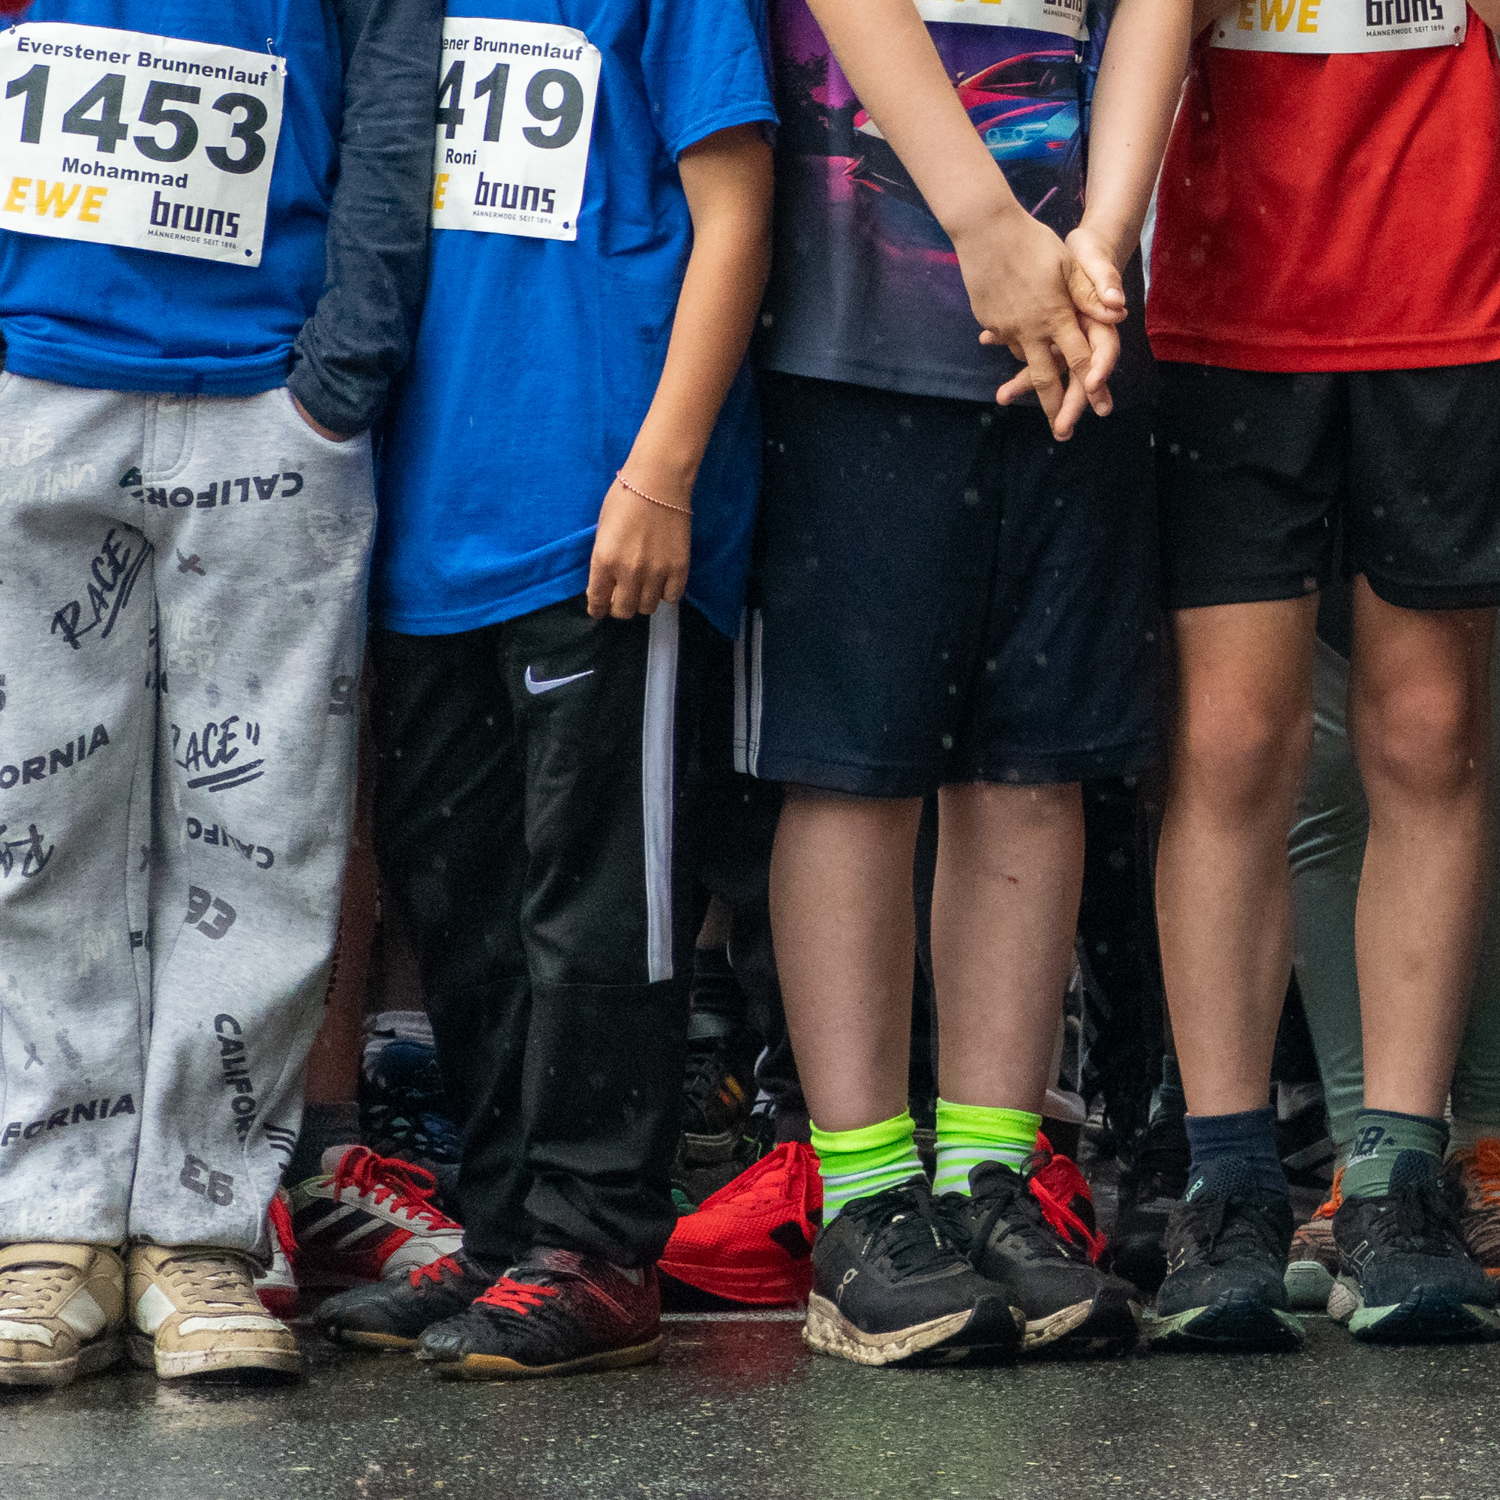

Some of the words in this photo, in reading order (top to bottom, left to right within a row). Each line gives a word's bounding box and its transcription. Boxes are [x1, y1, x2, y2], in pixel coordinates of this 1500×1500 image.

[17, 37, 131, 65] Everstener
[138, 52, 268, 86] Brunnenlauf
[474, 36, 583, 61] Brunnenlauf
[5, 64, 268, 174] 1453
[436, 60, 584, 150] 419
[62, 157, 188, 188] Mohammad
[445, 148, 477, 165] Roni
[2, 177, 108, 223] EWE
[150, 191, 241, 238] bruns
[474, 171, 556, 214] bruns
[203, 237, 219, 246] SEIT
[0, 723, 110, 789] ORNIA
[1, 1094, 136, 1147] FORNIA
